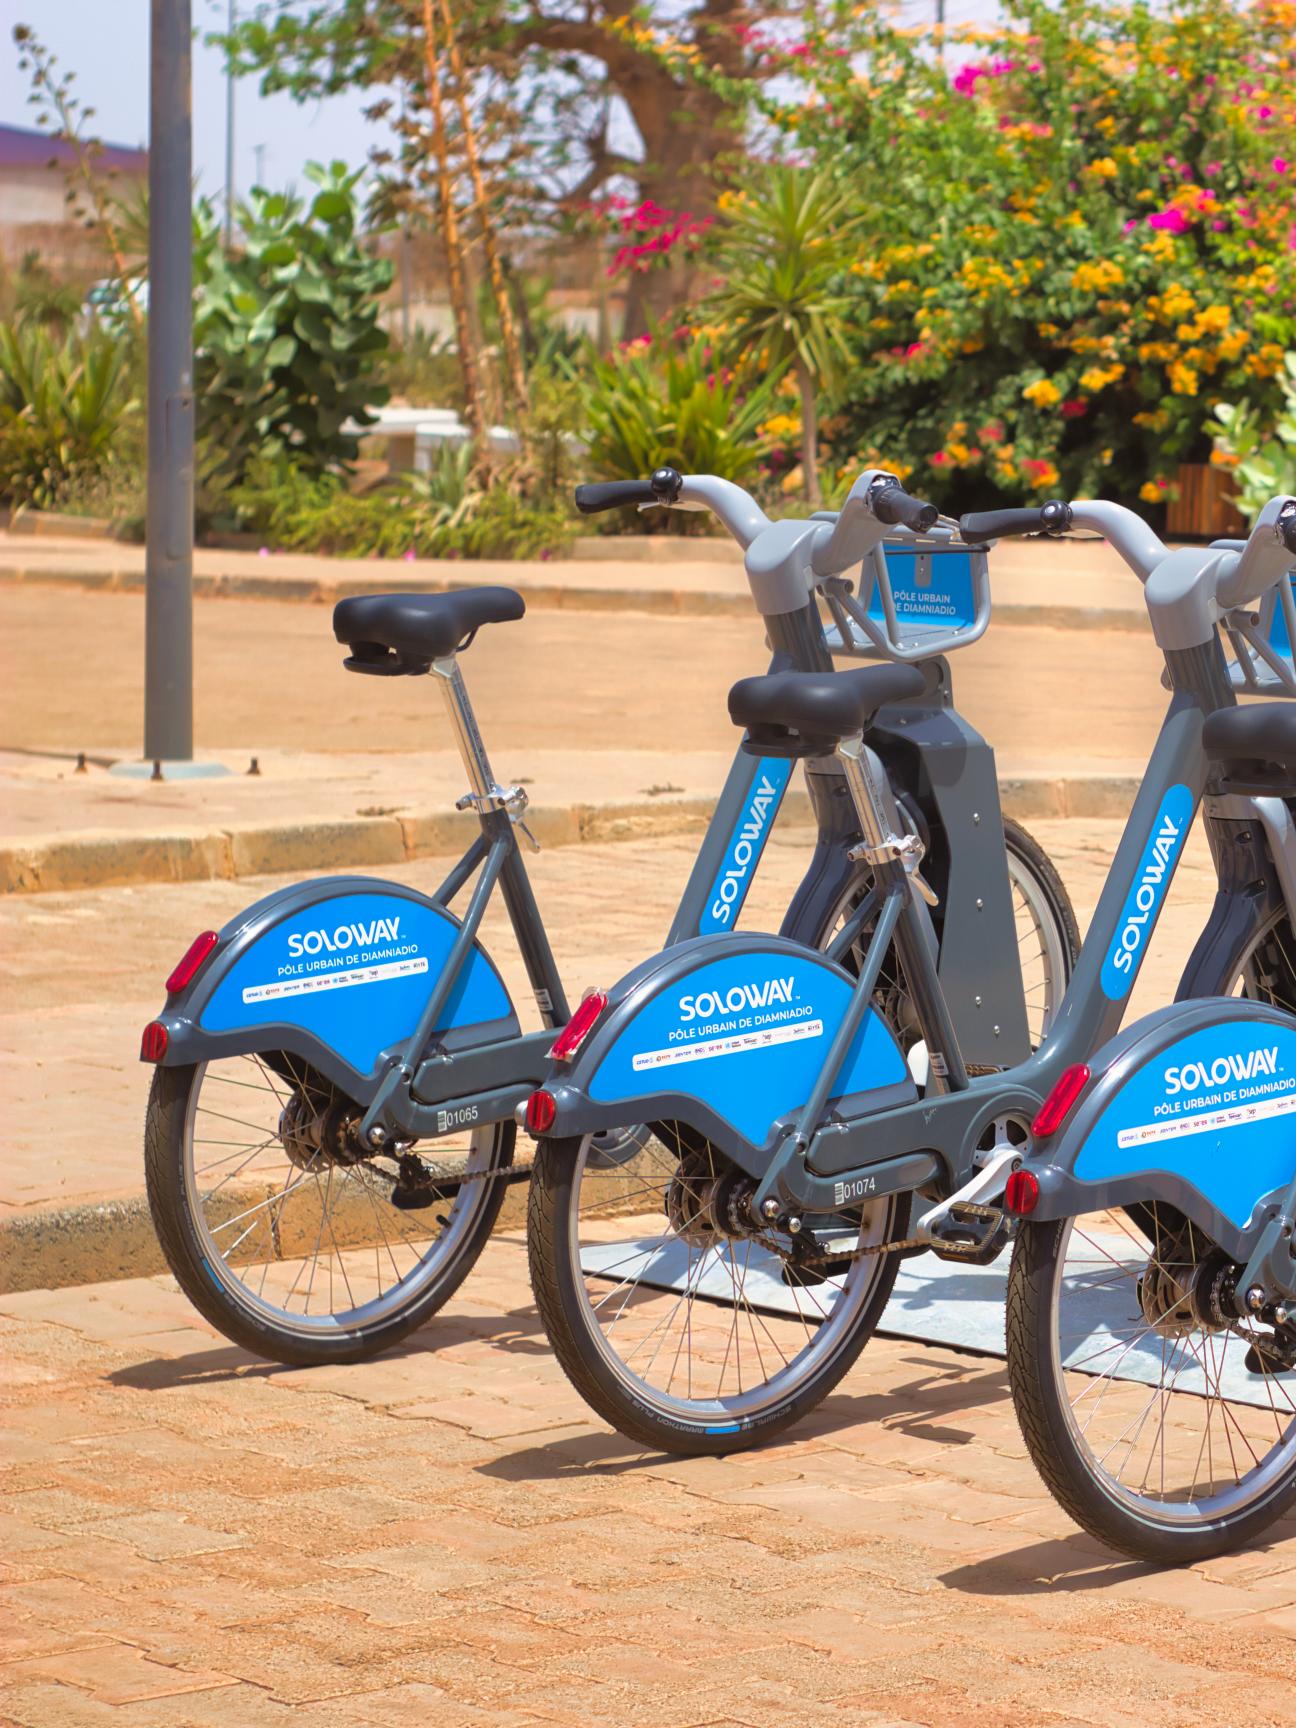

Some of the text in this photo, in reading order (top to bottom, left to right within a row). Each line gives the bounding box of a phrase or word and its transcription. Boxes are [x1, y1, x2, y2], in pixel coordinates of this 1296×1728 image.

[894, 590, 950, 604] PÔLE URBAIN
[904, 603, 956, 615] DIAMNIADIO
[712, 776, 776, 923] SOLOWAY
[1114, 815, 1180, 973] SOLOWAY
[288, 916, 400, 958] SOLOWAY
[278, 944, 418, 977] PÔLE URBAIN DE DIAMNIADIO
[679, 976, 795, 1022] SOLOWAY
[668, 1005, 813, 1042] PÔLE URBAIN DE DIAMNIADIO
[1164, 1046, 1279, 1095] SOLOWAY
[446, 1106, 478, 1126] 01065
[1154, 1078, 1296, 1117] PÔLE URBAIN DE DIAMNIADIO
[844, 1176, 876, 1198] 01074
